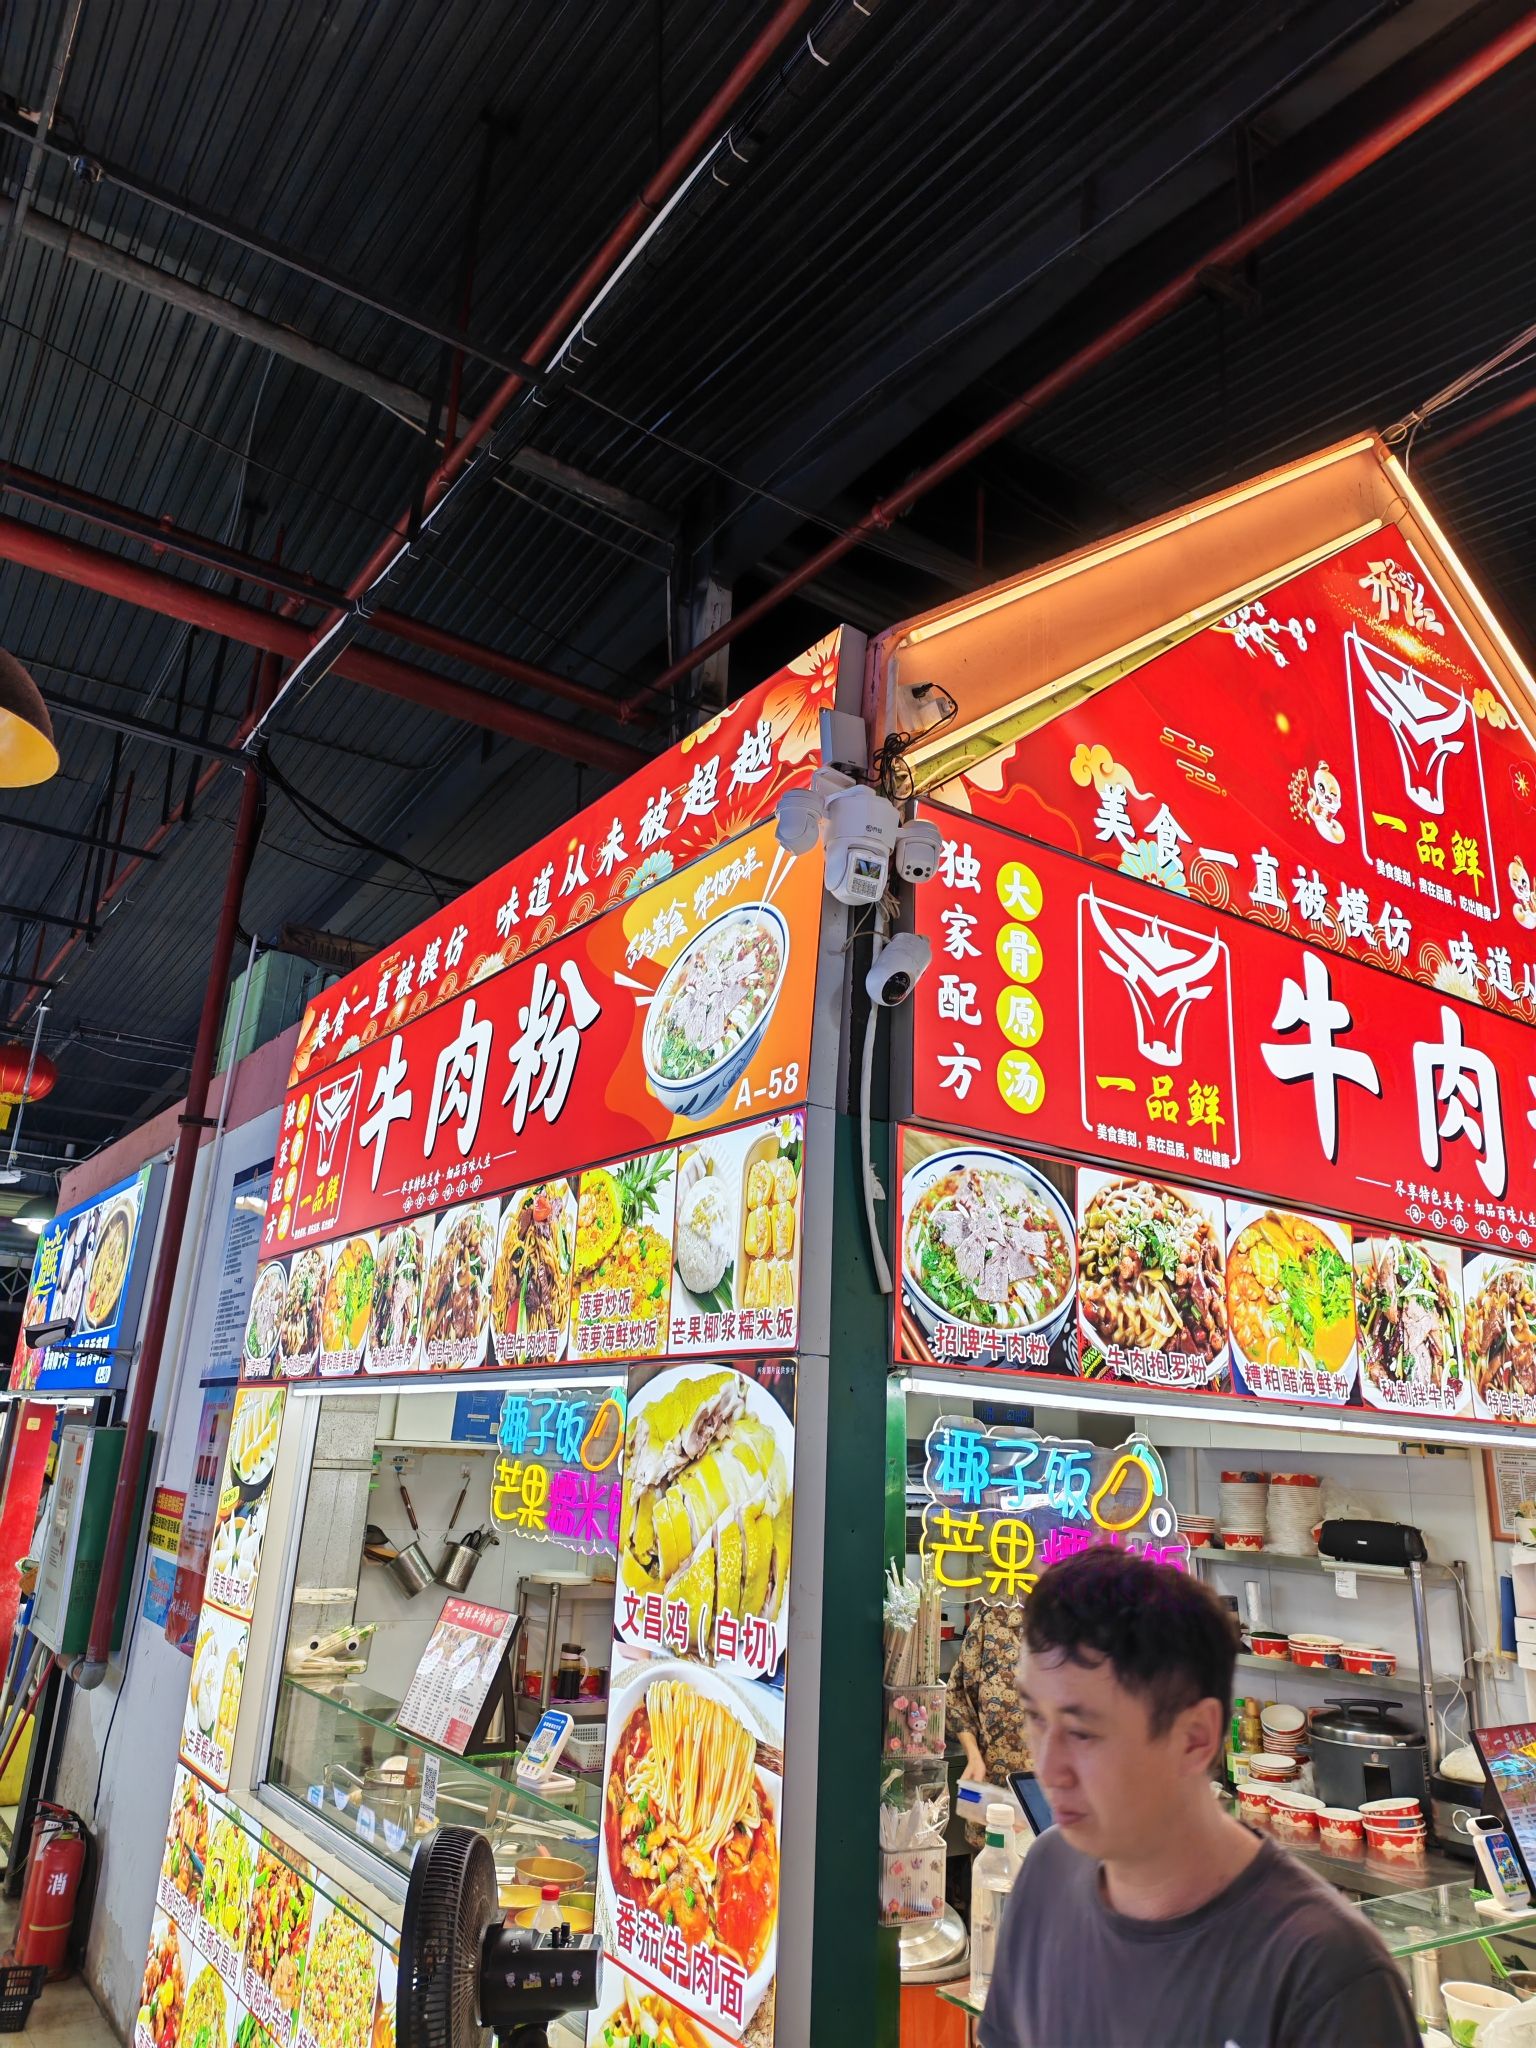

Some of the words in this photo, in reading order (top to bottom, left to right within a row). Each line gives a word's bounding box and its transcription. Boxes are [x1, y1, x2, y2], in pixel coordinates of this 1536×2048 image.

[1359, 561, 1445, 636] 开门红
[495, 719, 775, 937] 味道从未被超越
[1372, 811, 1485, 897] 一品鲜
[1094, 784, 1412, 957] 美食一直被模仿
[313, 925, 467, 1048] 美食一直被模仿
[937, 840, 983, 1101] 独家配方
[1002, 867, 1040, 1107] 大骨原汤
[359, 960, 601, 1192] 牛肉粉
[734, 1063, 800, 1111] A-58
[1262, 950, 1536, 1200] 牛肉
[1096, 1074, 1226, 1146] 一品鲜
[1097, 1123, 1231, 1170] 美食美刻，贵在品质，吃出健康
[300, 1173, 340, 1215] 一品鲜
[577, 1318, 657, 1352] 菠萝海鲜炒饭
[579, 1288, 632, 1319] 菠萝炒饭
[672, 1308, 794, 1345] 芒果椰浆糯米饭
[495, 1330, 559, 1360] 特色牛肉炒面
[935, 1323, 1050, 1366] 招牌牛肉粉
[1106, 1346, 1208, 1385] 牛肉抱罗粉
[1244, 1363, 1350, 1400] 糟粕醋海鲜粉
[1380, 1378, 1456, 1410] 秘制拌牛肉
[501, 1395, 586, 1464] 椰子饭
[935, 1429, 1092, 1521] 椰子饭
[47, 1873, 68, 1895] 消
[615, 1896, 748, 2029] 番茄牛肉面
